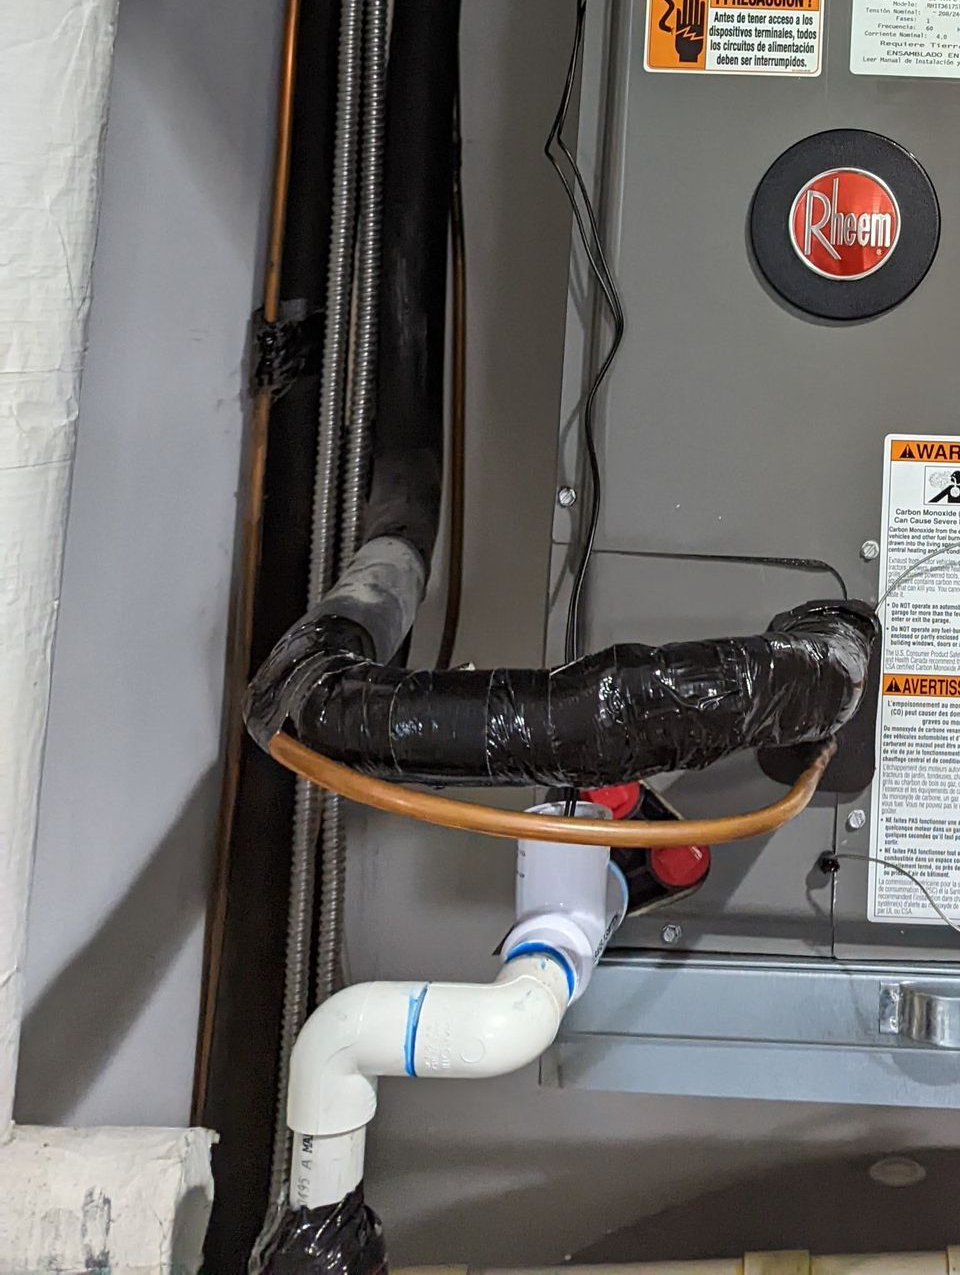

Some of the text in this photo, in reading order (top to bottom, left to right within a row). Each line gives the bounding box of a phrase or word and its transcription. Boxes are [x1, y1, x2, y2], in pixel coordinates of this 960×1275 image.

[713, 11, 813, 25] Antes de tener acceso a los
[709, 25, 816, 40] dispositivos terminales, todos
[710, 39, 814, 53] los circuitos de alimentación
[716, 53, 807, 69] deben ser interrumpidos.
[886, 50, 942, 58] ENSAMBLADO
[804, 177, 891, 260] Rheem
